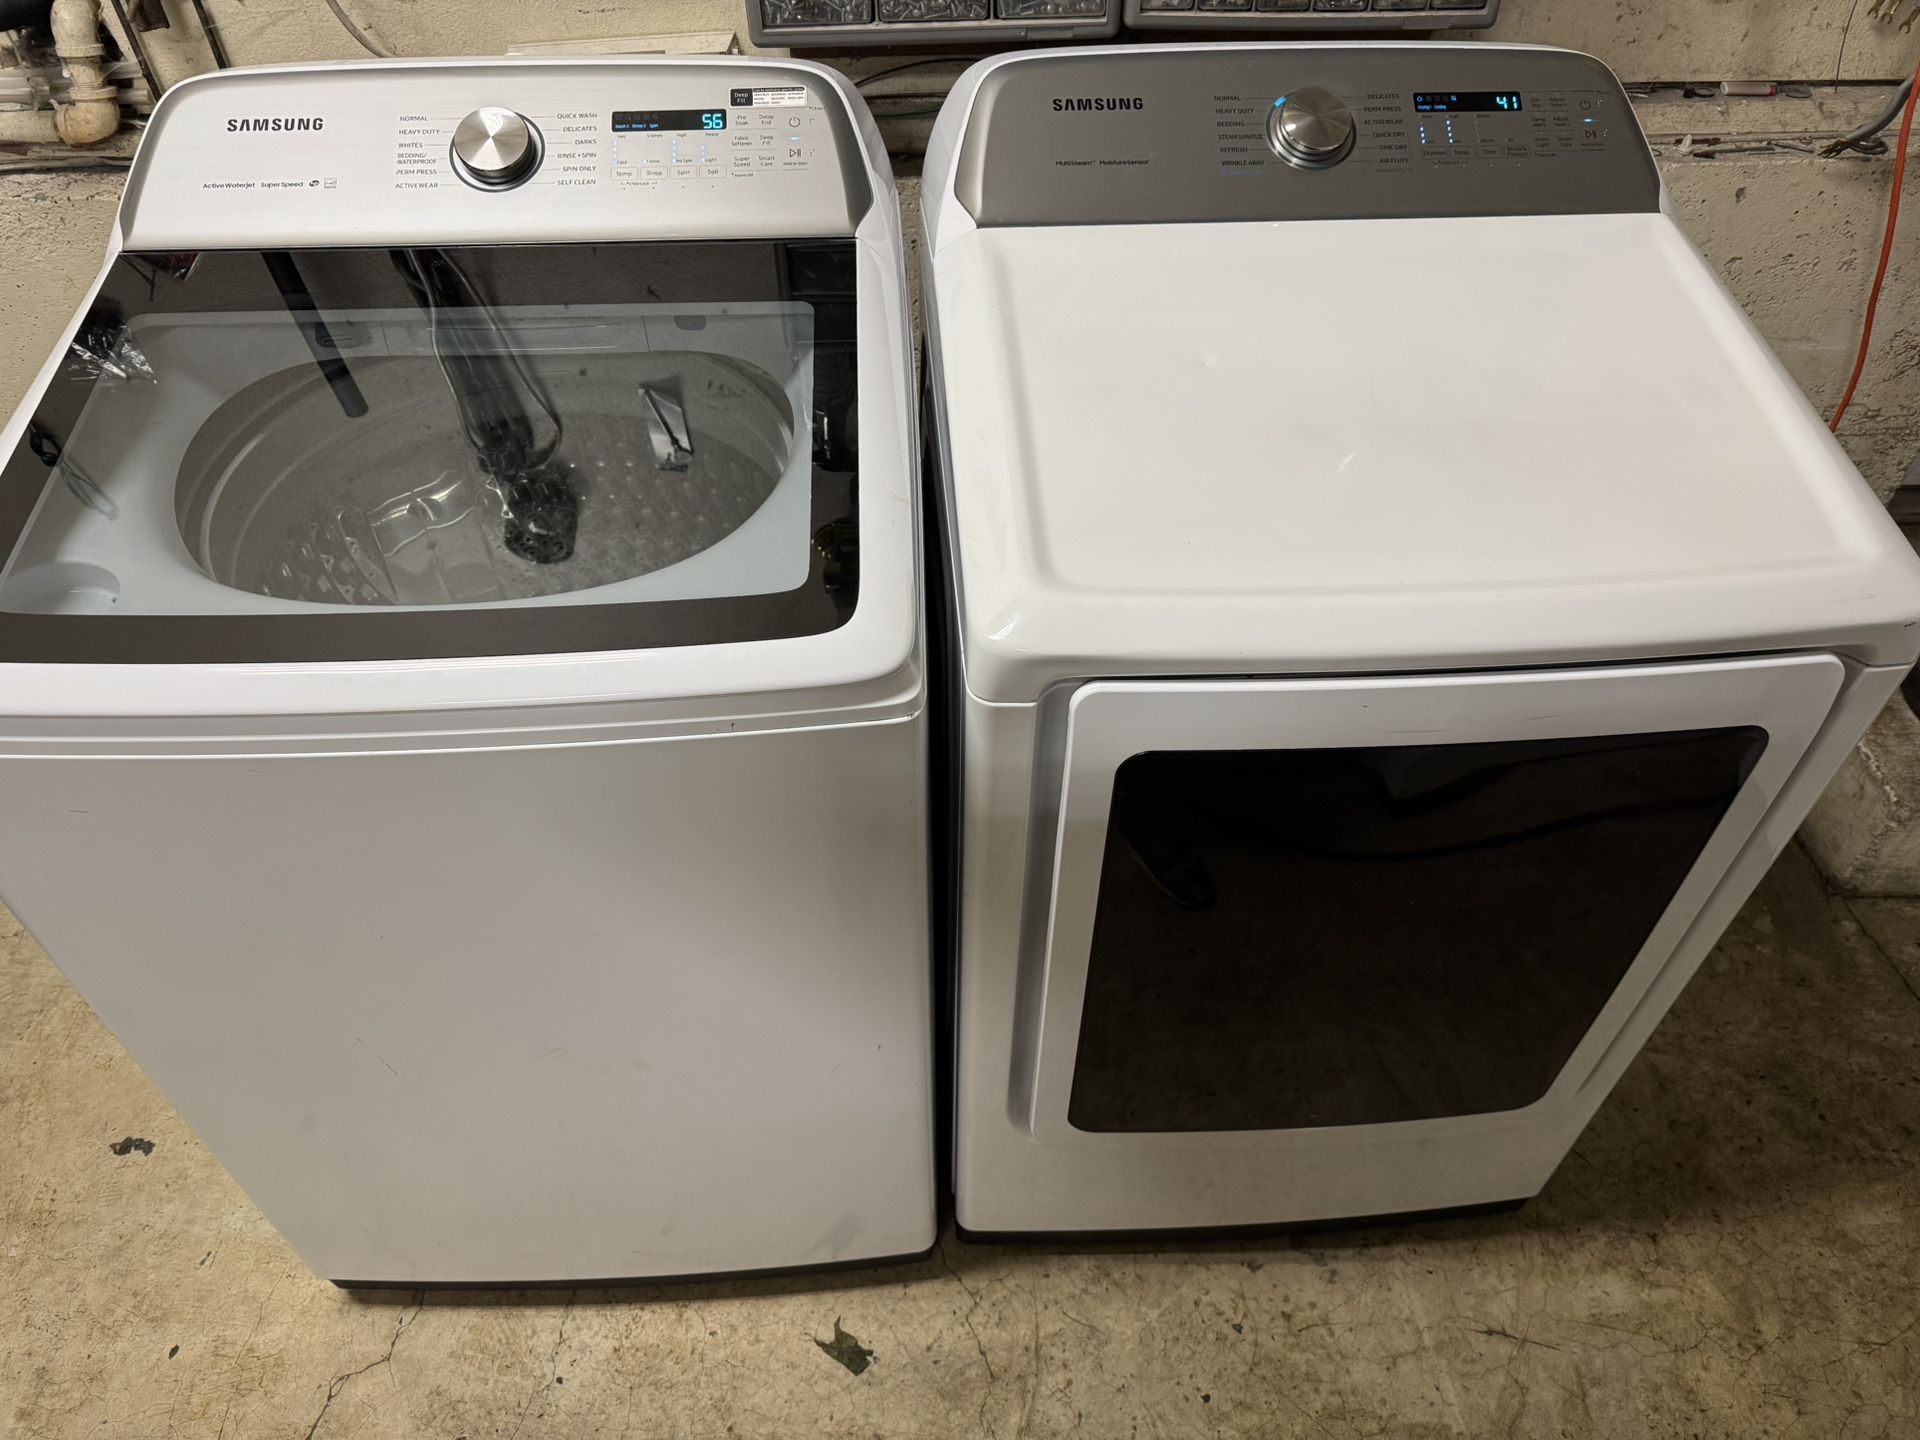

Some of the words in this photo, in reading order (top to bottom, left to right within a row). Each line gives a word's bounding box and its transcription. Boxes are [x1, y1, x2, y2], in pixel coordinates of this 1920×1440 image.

[1052, 98, 1143, 111] SAMSUNG
[1496, 96, 1518, 110] 41
[226, 118, 324, 132] SAMSUNG
[702, 113, 723, 129] 56
